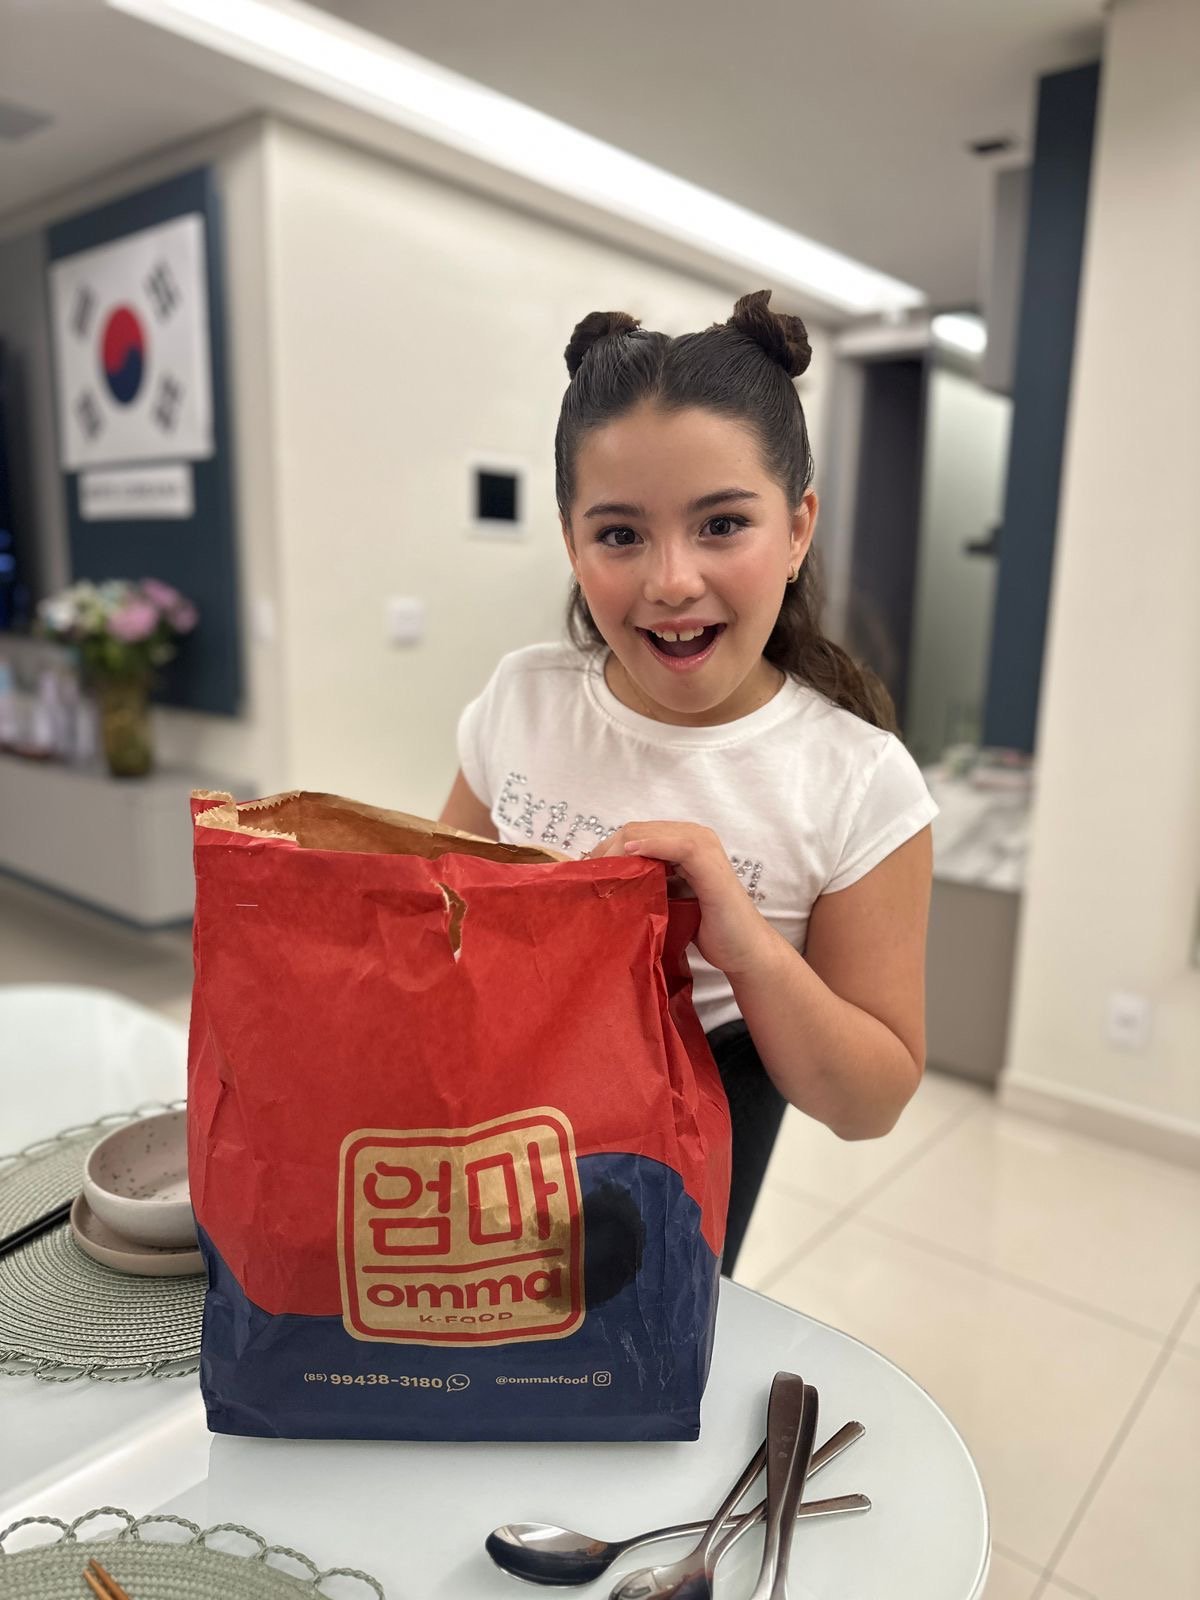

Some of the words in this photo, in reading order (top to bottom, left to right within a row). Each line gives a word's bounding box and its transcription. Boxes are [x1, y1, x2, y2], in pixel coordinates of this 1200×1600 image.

[363, 1141, 558, 1256] 엄마
[366, 1268, 562, 1309] omma
[419, 1311, 513, 1323] K-FOOD
[303, 1372, 328, 1383] (85)
[330, 1373, 443, 1389] 99438-3180
[495, 1375, 588, 1385] @ommakfood
